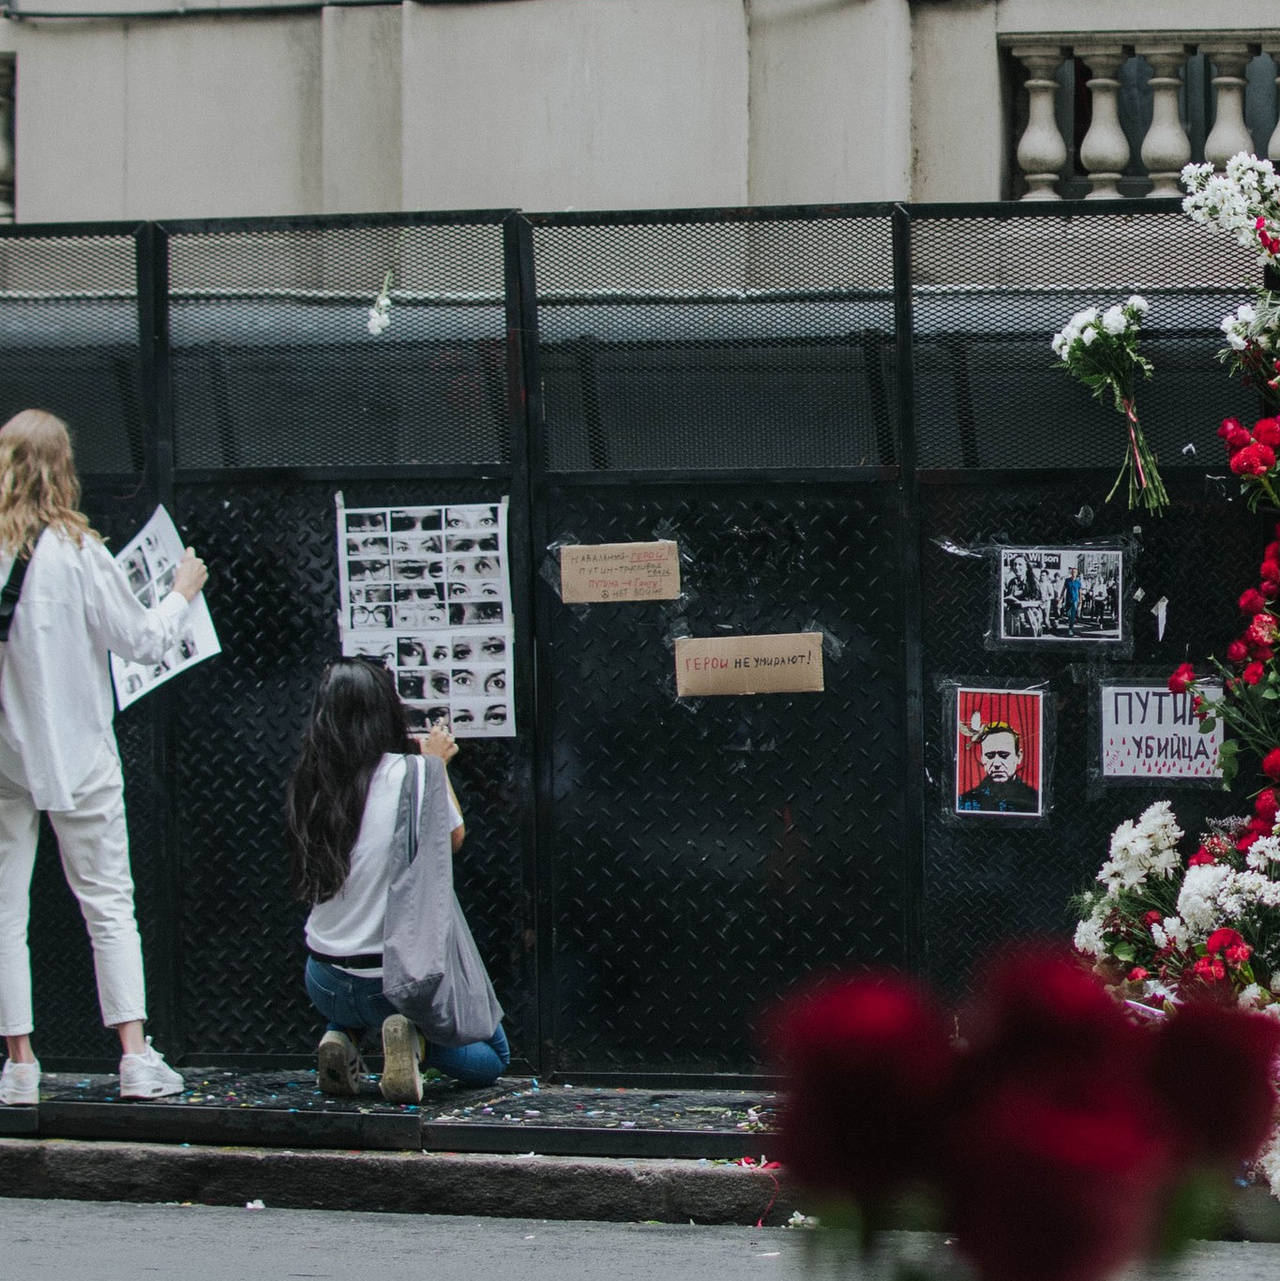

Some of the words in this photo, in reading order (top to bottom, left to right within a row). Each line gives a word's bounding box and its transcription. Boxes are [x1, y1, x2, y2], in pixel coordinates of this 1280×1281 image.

[734, 657, 750, 669] НЕ
[754, 650, 812, 668] УМИРАЮТ!
[1132, 733, 1210, 762] УБИЙЦА
